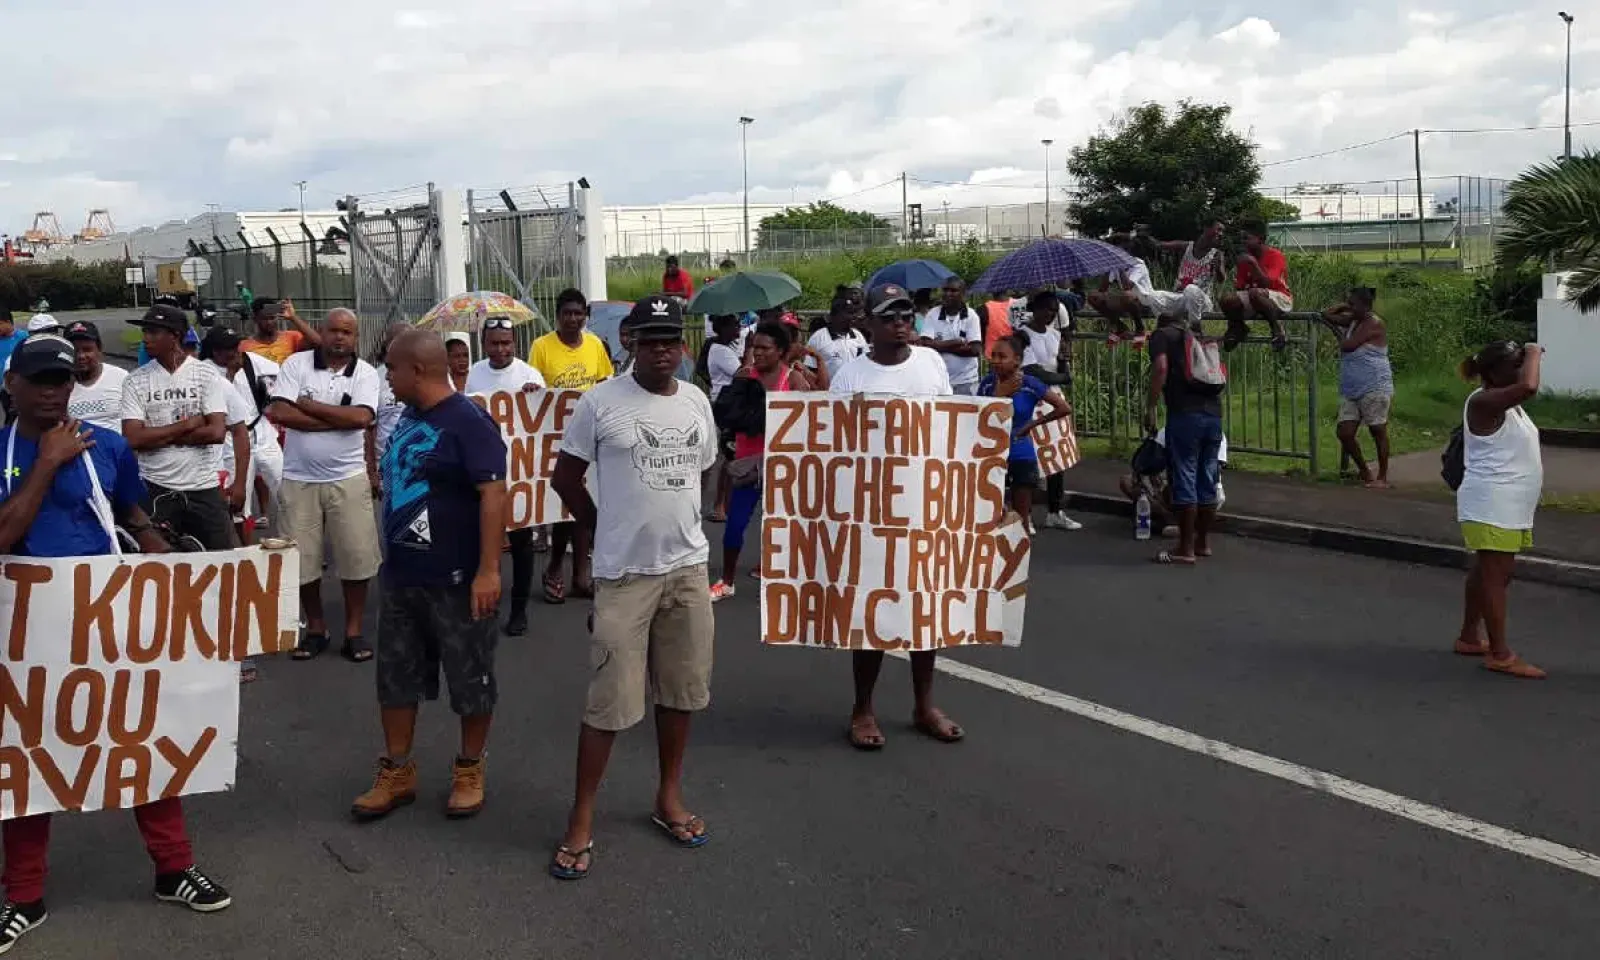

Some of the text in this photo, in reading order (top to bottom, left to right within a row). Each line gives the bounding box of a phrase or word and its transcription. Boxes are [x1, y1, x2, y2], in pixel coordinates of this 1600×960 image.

[146, 387, 198, 403] JEANS
[768, 399, 1012, 459] ZENFANTS
[765, 454, 1007, 535] ROCHE BOIS
[761, 516, 1031, 592] ENVI TRAVAY
[0, 663, 161, 748] NOU
